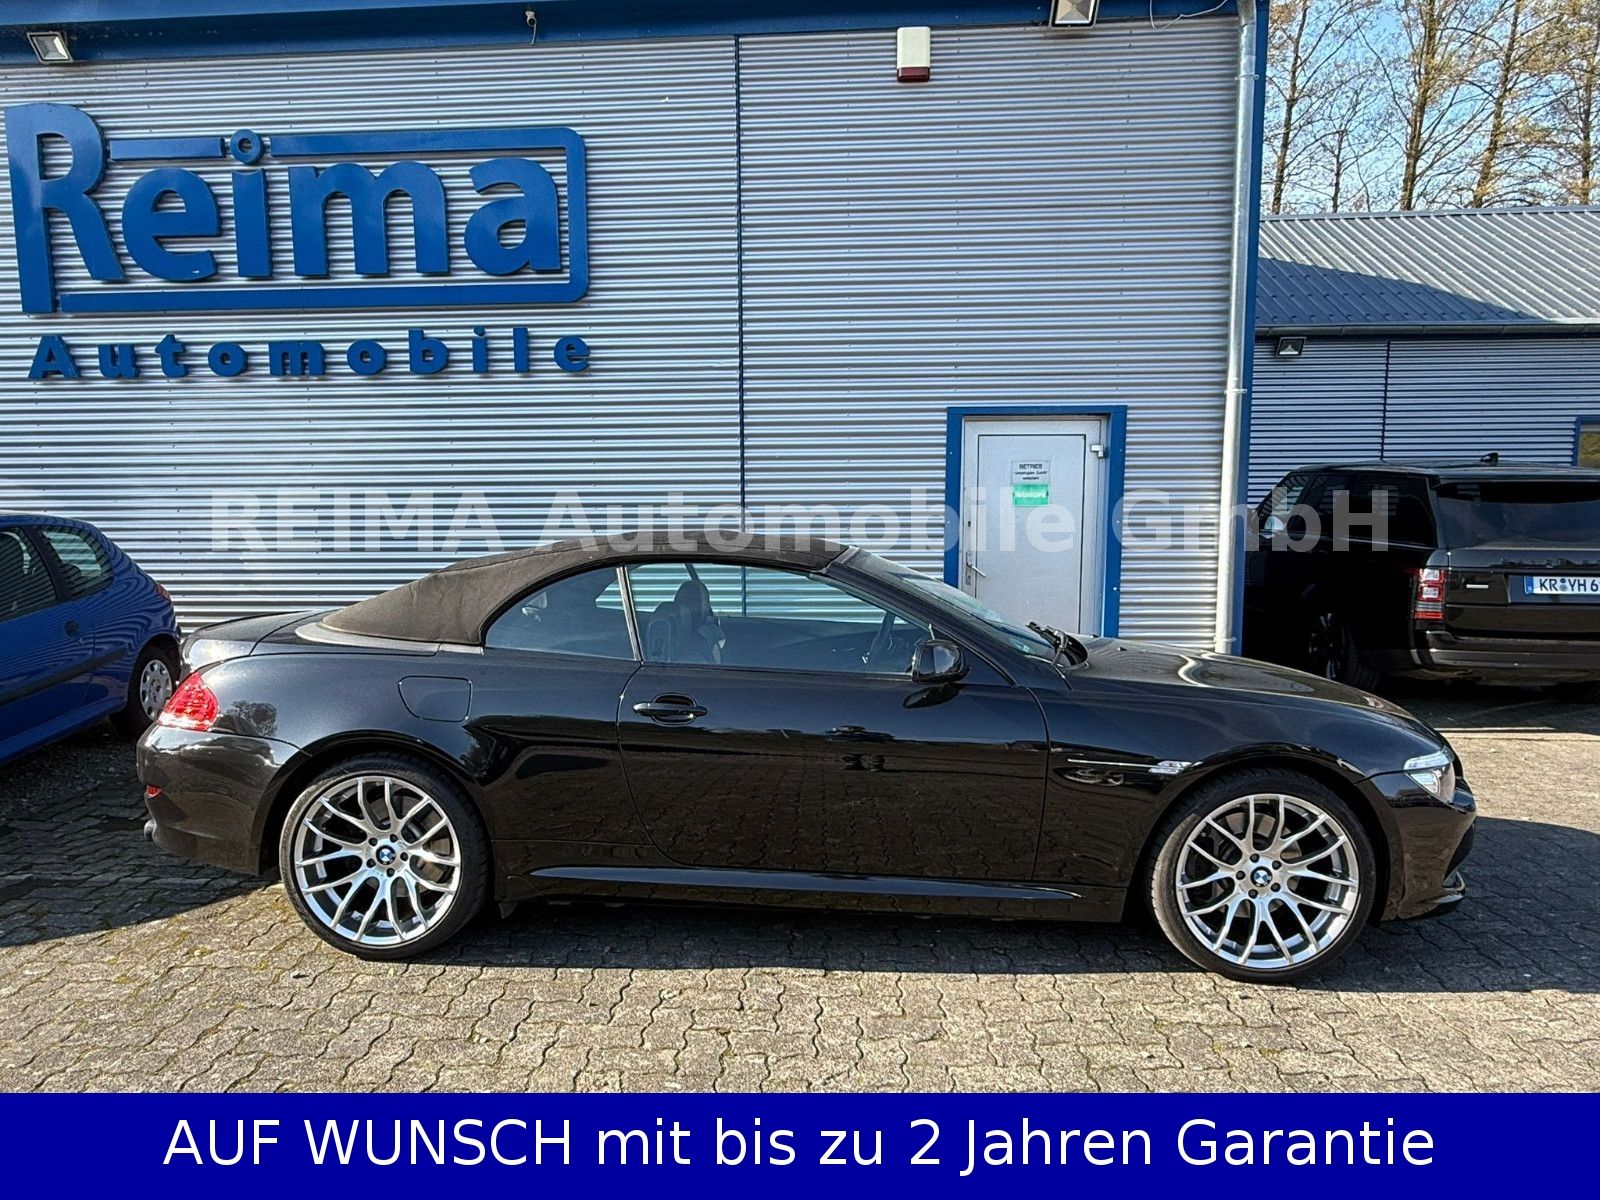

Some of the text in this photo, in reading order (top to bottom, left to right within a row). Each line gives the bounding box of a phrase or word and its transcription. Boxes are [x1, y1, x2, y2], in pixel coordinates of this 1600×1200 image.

[4, 103, 562, 314] Reima
[28, 327, 591, 379] Automobile
[1539, 578, 1600, 592] KR YH 6
